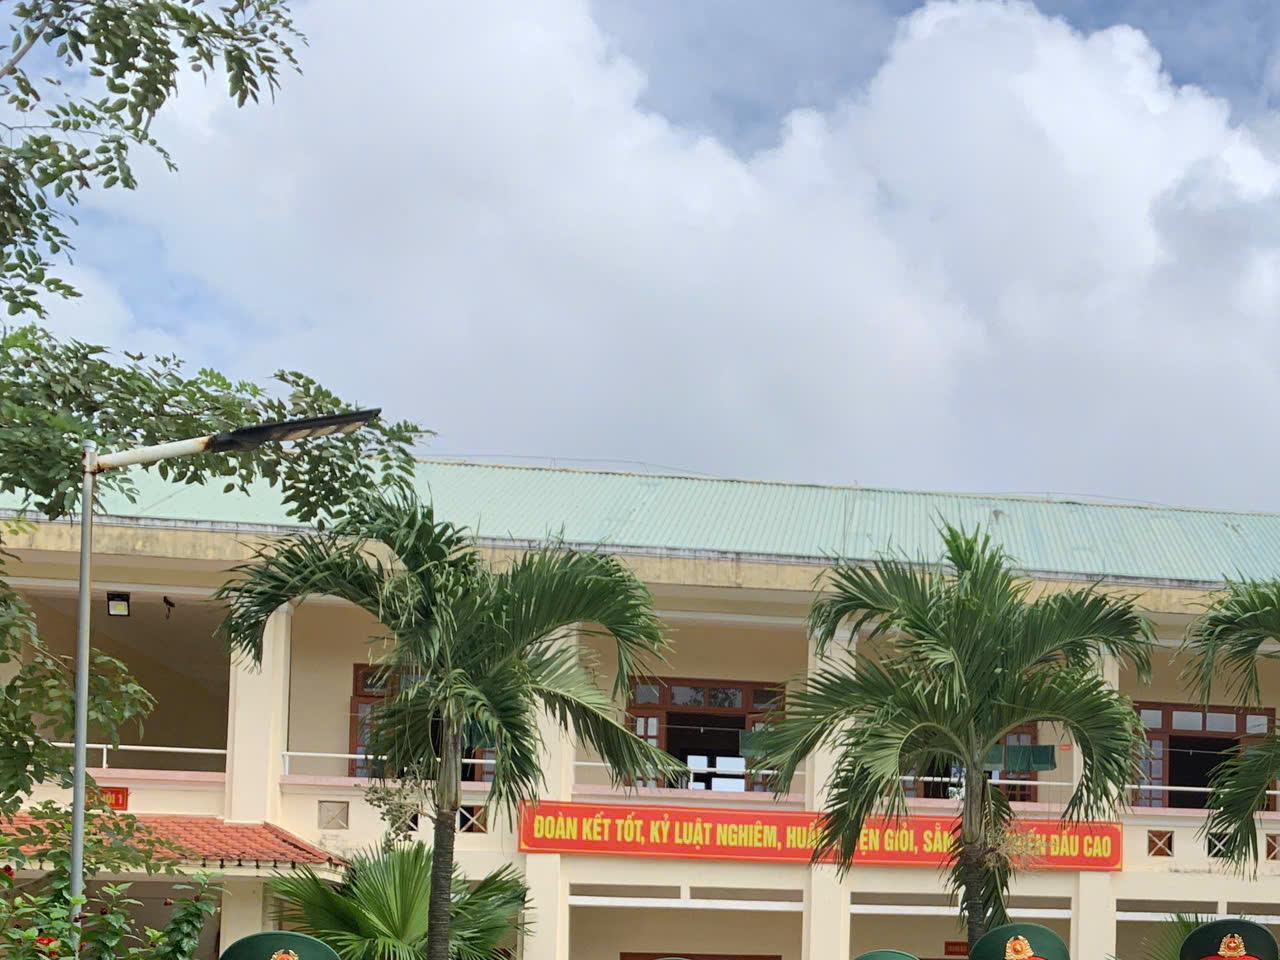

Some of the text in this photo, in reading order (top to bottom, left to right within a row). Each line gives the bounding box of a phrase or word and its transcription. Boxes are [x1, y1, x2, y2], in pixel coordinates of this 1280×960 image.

[533, 811, 578, 841] ĐOÀN
[581, 811, 611, 842] KẾT
[615, 811, 645, 846] TỐT,
[649, 813, 671, 844] KỶ
[674, 817, 713, 850] LUẬT
[716, 820, 782, 851] NGHIÊM,
[883, 822, 918, 855] GIỎI,
[1050, 827, 1080, 857] ĐẤU
[1083, 835, 1112, 858] CAO
